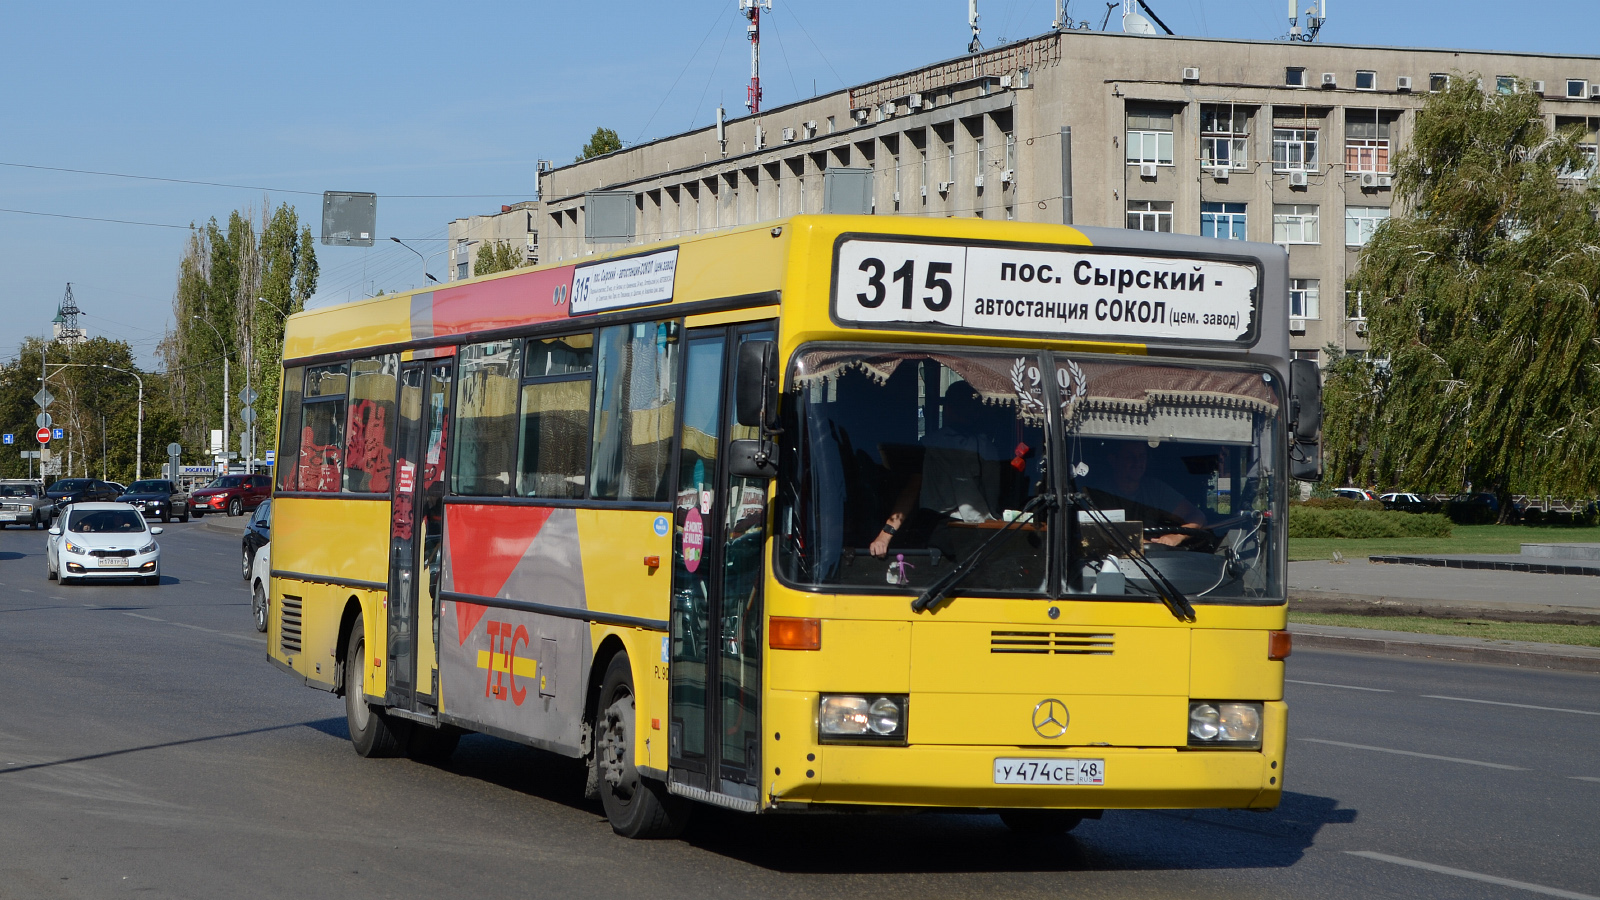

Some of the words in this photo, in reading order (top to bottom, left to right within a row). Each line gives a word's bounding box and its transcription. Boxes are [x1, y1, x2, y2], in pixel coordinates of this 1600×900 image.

[574, 276, 590, 303] 315
[856, 256, 953, 312] 315
[1001, 262, 1061, 284] пос.
[1073, 260, 1205, 294] Сырский
[975, 298, 1089, 323] автостанция
[1095, 298, 1166, 324] СОКОЛ
[1169, 307, 1199, 327] (цем.
[1203, 311, 1240, 330] завод)
[486, 620, 530, 706] TEC
[654, 665, 661, 679] PL
[1003, 762, 1075, 781] У474СЕ
[1080, 762, 1097, 777] 48
